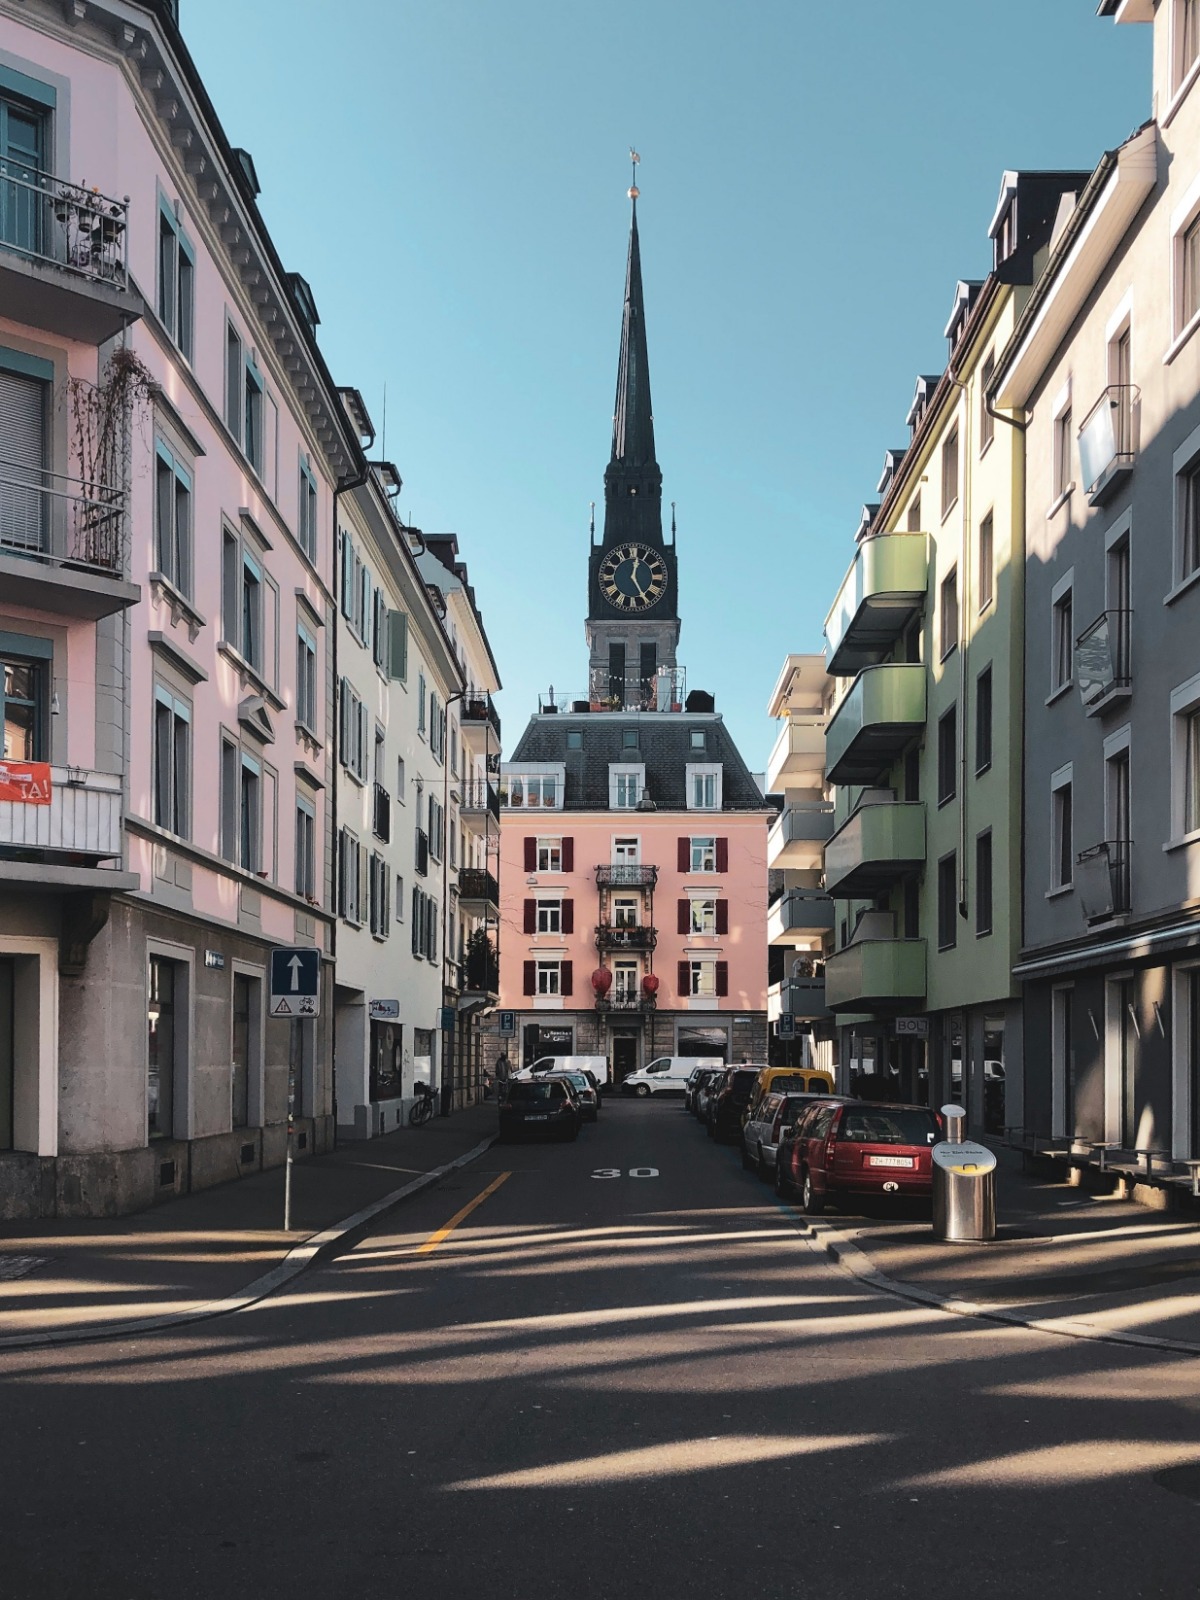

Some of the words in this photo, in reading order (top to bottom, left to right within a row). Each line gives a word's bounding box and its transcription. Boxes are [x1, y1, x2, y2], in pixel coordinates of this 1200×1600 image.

[504, 1014, 511, 1023] P
[784, 1016, 790, 1024] P
[590, 1167, 660, 1179] 30
